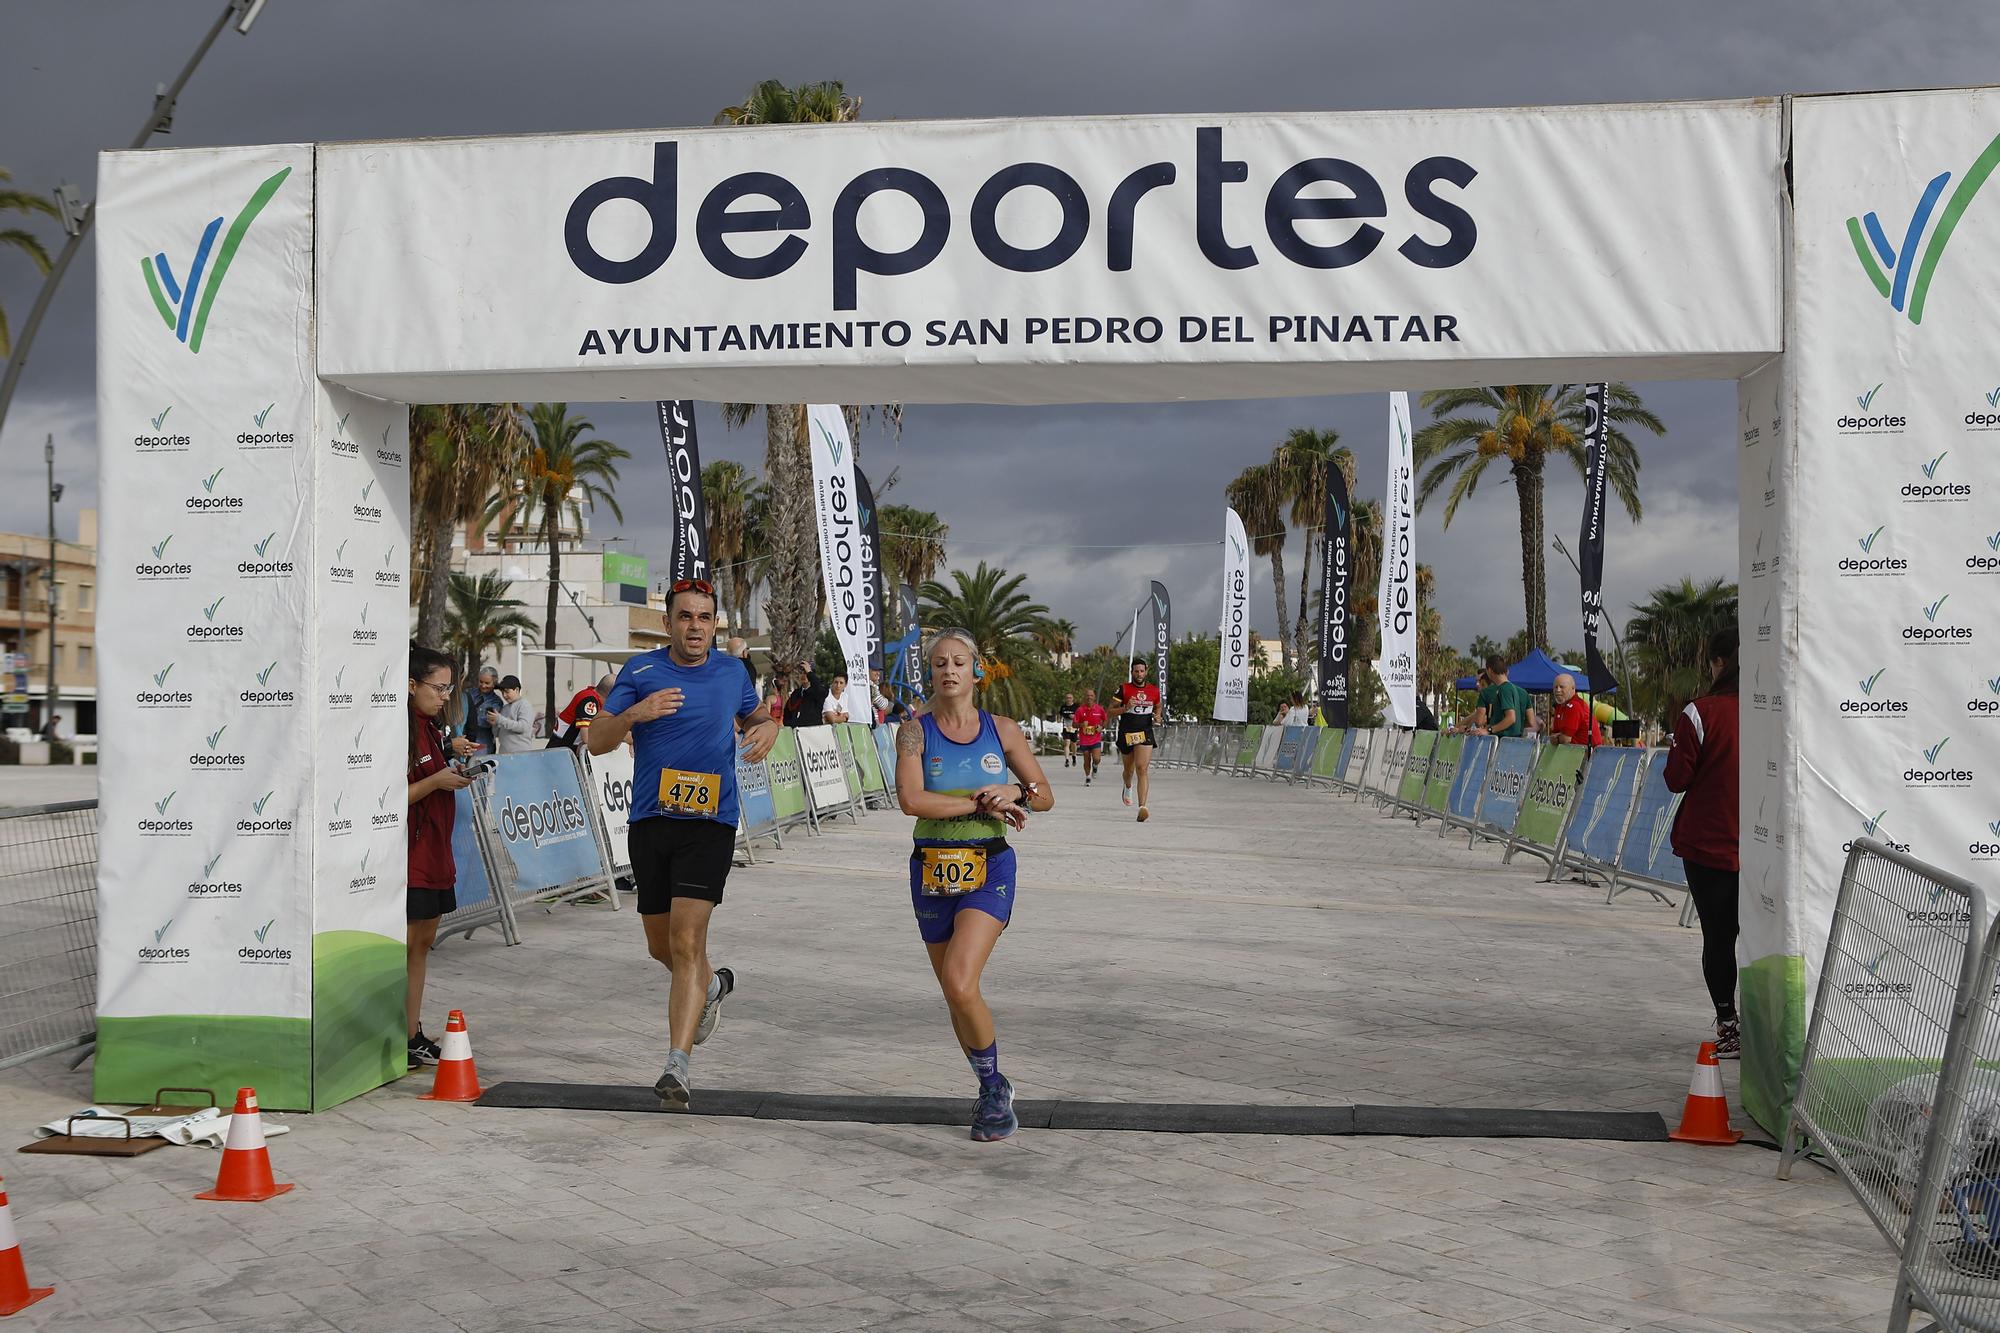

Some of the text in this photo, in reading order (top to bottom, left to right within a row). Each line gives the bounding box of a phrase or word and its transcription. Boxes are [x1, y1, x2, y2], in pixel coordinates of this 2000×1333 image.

[564, 126, 1479, 311] deportes
[579, 315, 1460, 355] AYUNTAMIENTO SAN PEDRO DEL PINATAR
[1838, 415, 1905, 430] deportes
[1965, 412, 2000, 426] dep
[135, 435, 189, 446] deportes
[237, 432, 293, 445] deportes
[332, 440, 358, 453] deportes
[377, 448, 401, 463] deportes
[1901, 483, 1970, 498] deportes
[186, 496, 242, 509] deportes
[354, 504, 381, 517] deportes
[136, 563, 191, 575] deportes
[238, 561, 293, 574] deportes
[1839, 557, 1907, 572] deportes
[1966, 556, 2000, 570] dep
[331, 567, 353, 577] deportes
[376, 570, 400, 582] deportes
[187, 625, 243, 638] deportes
[353, 631, 377, 639] deportes
[1903, 626, 1972, 641] deportes
[137, 692, 192, 704] deportes
[241, 690, 293, 703] deportes
[329, 695, 352, 703] deportes
[371, 693, 396, 702] deportes
[1133, 705, 1149, 714] CT
[1840, 700, 1907, 714] deportes
[190, 754, 244, 766] deportes
[348, 754, 372, 763] deportes
[806, 744, 840, 778] deportes
[1904, 769, 1972, 783] deportes
[668, 782, 710, 806] 478
[372, 813, 398, 824] deportes
[501, 790, 586, 849] deportes
[139, 819, 192, 832] deportes
[237, 819, 291, 832] deportes
[329, 820, 351, 831] deportes
[932, 861, 976, 884] 402
[189, 882, 241, 895] deportes
[350, 876, 375, 888] deportes
[1906, 909, 1971, 924] deporte
[139, 947, 189, 960] deportes
[239, 947, 291, 960] deportes
